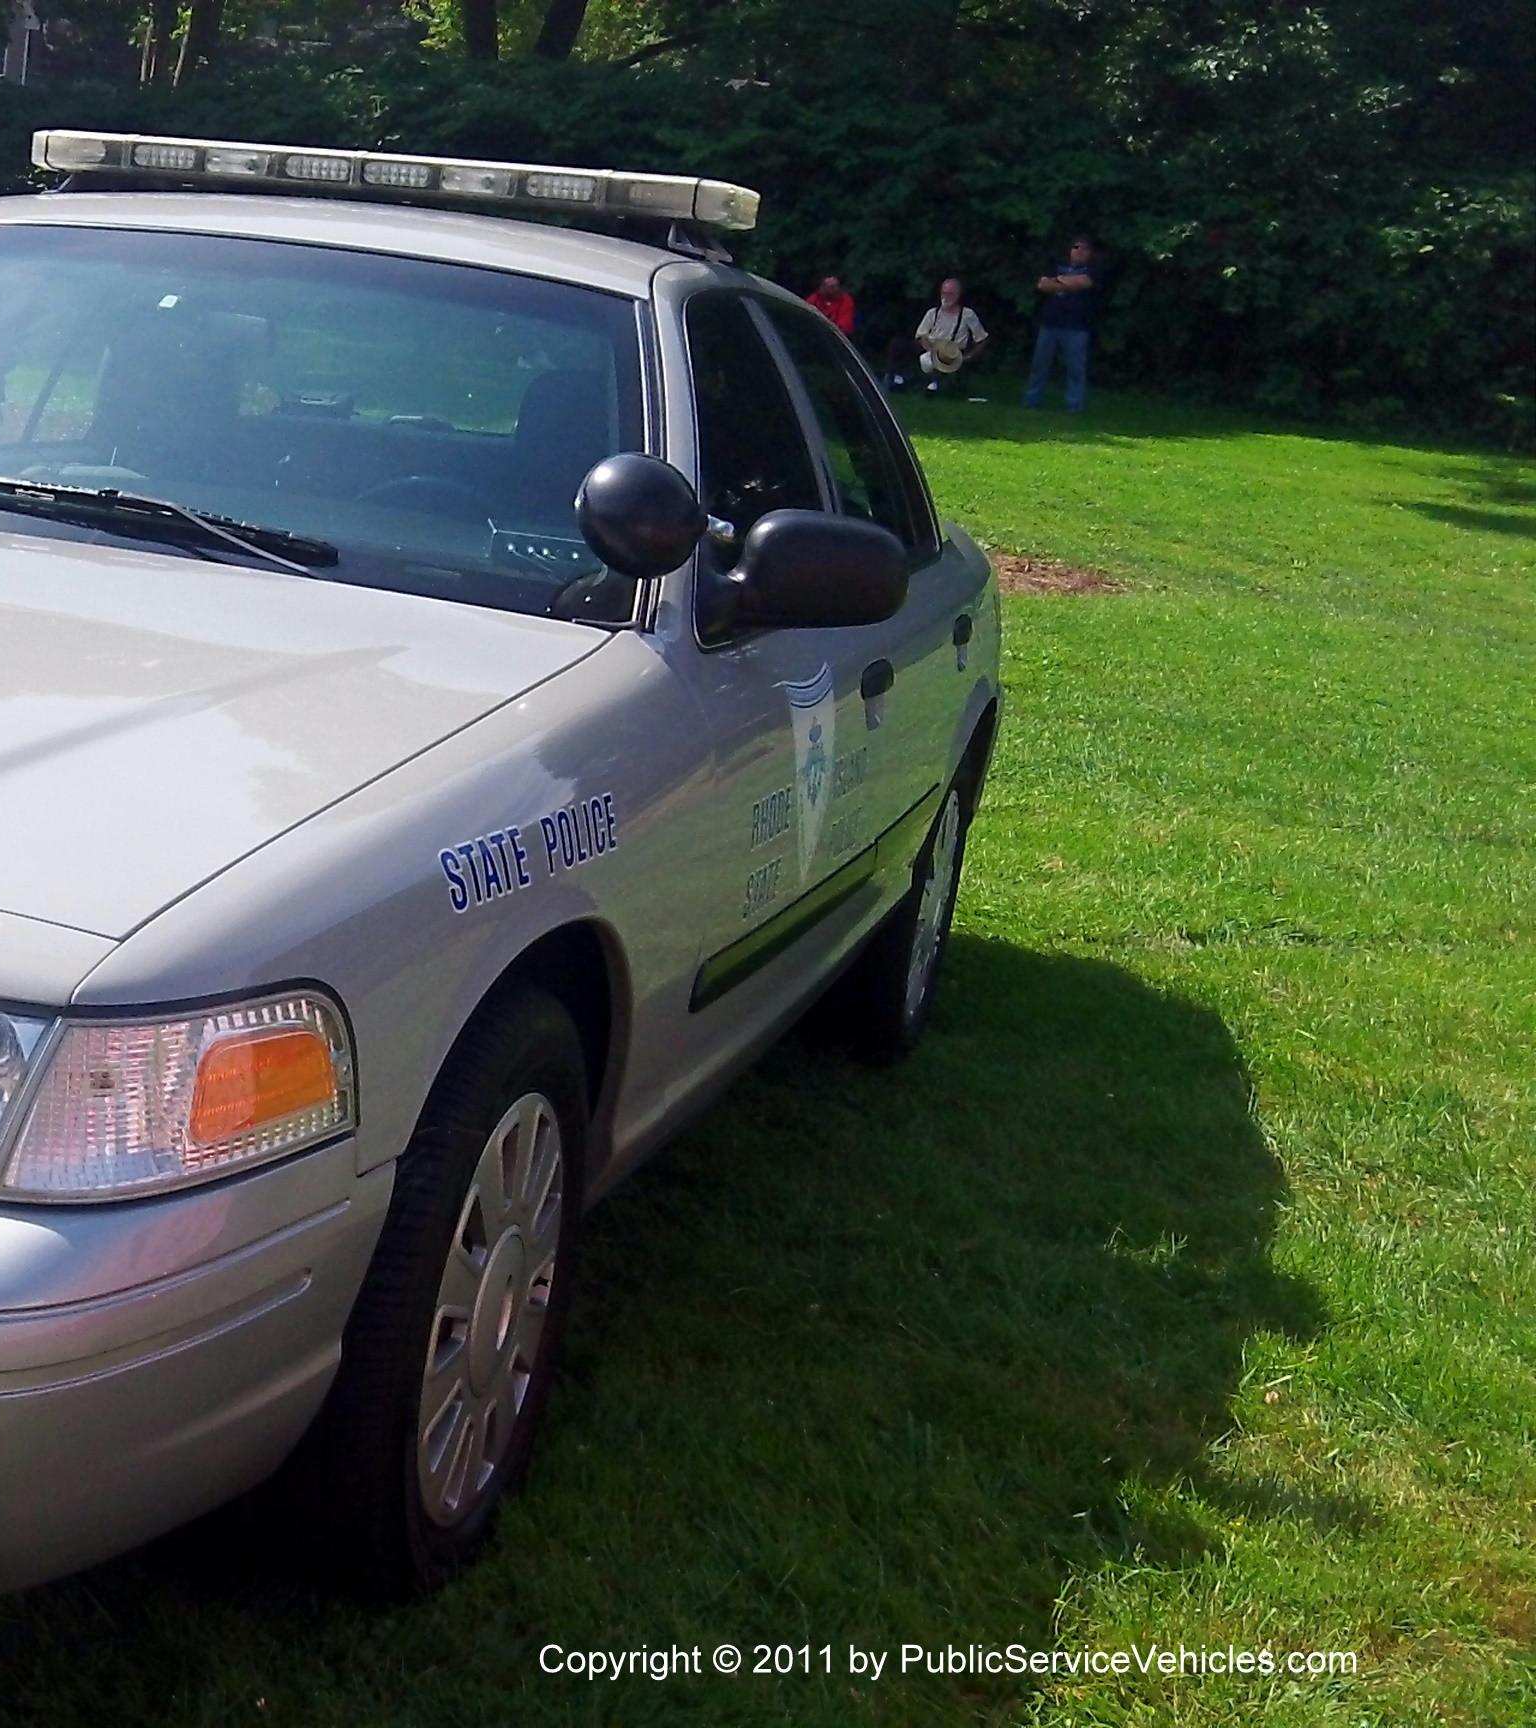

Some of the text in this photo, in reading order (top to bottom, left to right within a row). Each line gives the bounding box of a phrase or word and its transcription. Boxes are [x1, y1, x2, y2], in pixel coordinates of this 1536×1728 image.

[438, 792, 618, 914] STATE POLICE
[751, 784, 792, 852] RHODE
